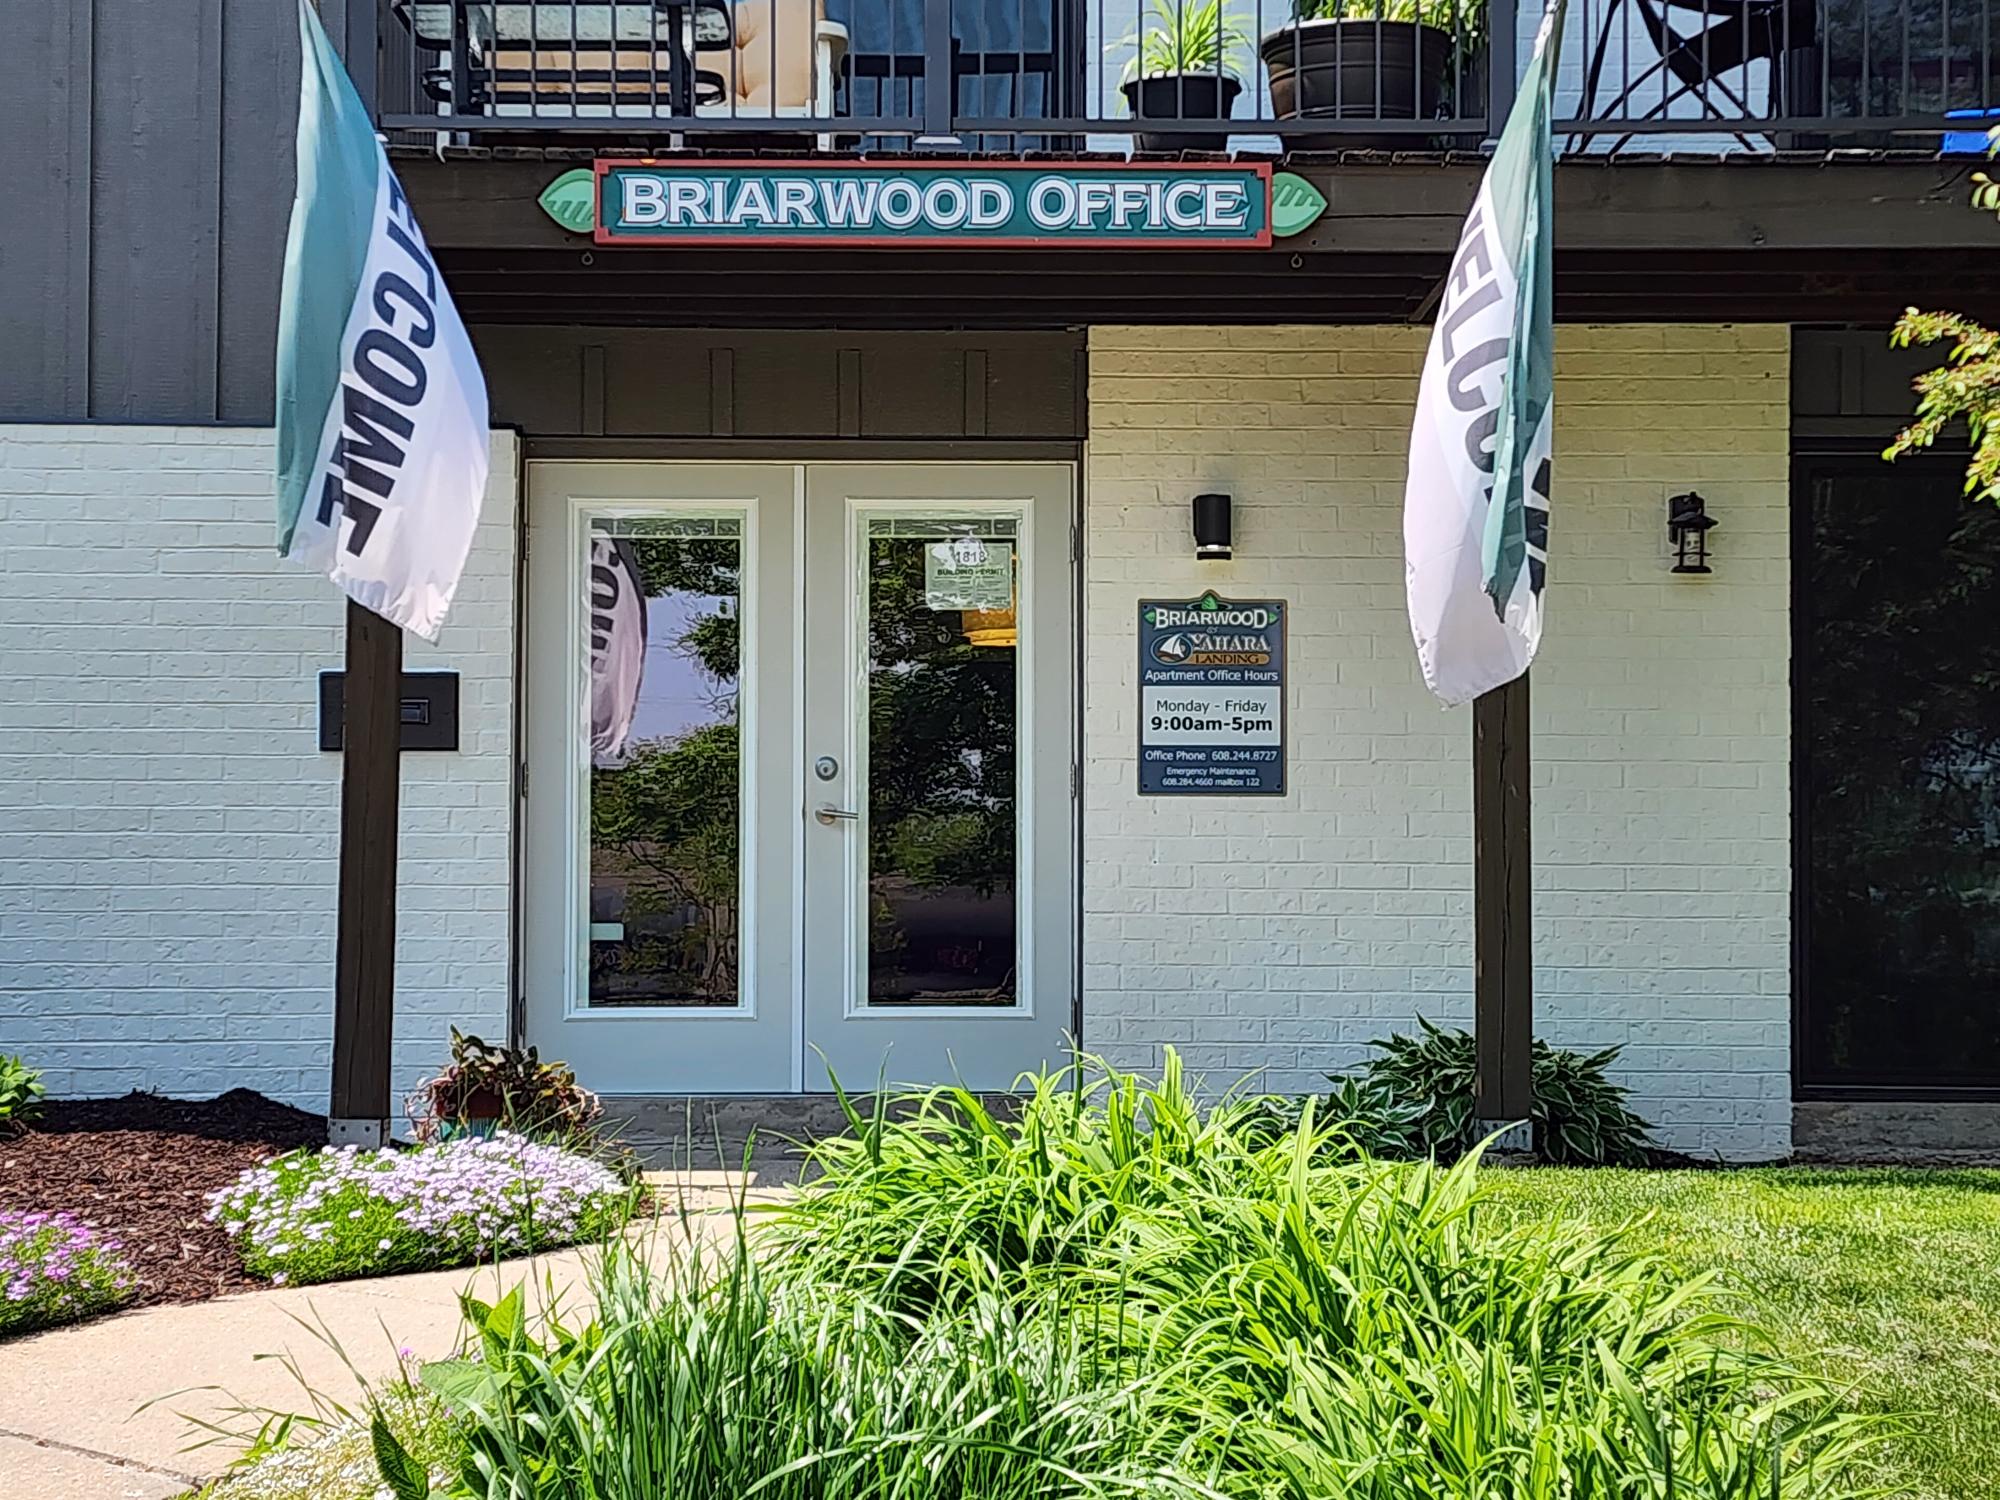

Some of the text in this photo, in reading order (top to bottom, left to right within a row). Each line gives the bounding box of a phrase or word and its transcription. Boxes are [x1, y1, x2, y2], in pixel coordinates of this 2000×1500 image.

[616, 174, 1251, 231] BRIARWOOD OFFICE
[1154, 607, 1268, 630] BRIARWOOD
[1186, 633, 1272, 652] YAHARA
[1195, 653, 1260, 664] LANDING
[1145, 669, 1279, 682] Apartment Office Hours
[1156, 699, 1210, 714] Monday
[1225, 699, 1267, 714] Friday
[1151, 716, 1273, 734] 9:00am-5pm
[1145, 750, 1278, 761] Office Phone 608.244.8727
[1166, 766, 1257, 777] Emergency Maintenance
[1215, 778, 1244, 787] mailbox
[1246, 778, 1260, 787] 122
